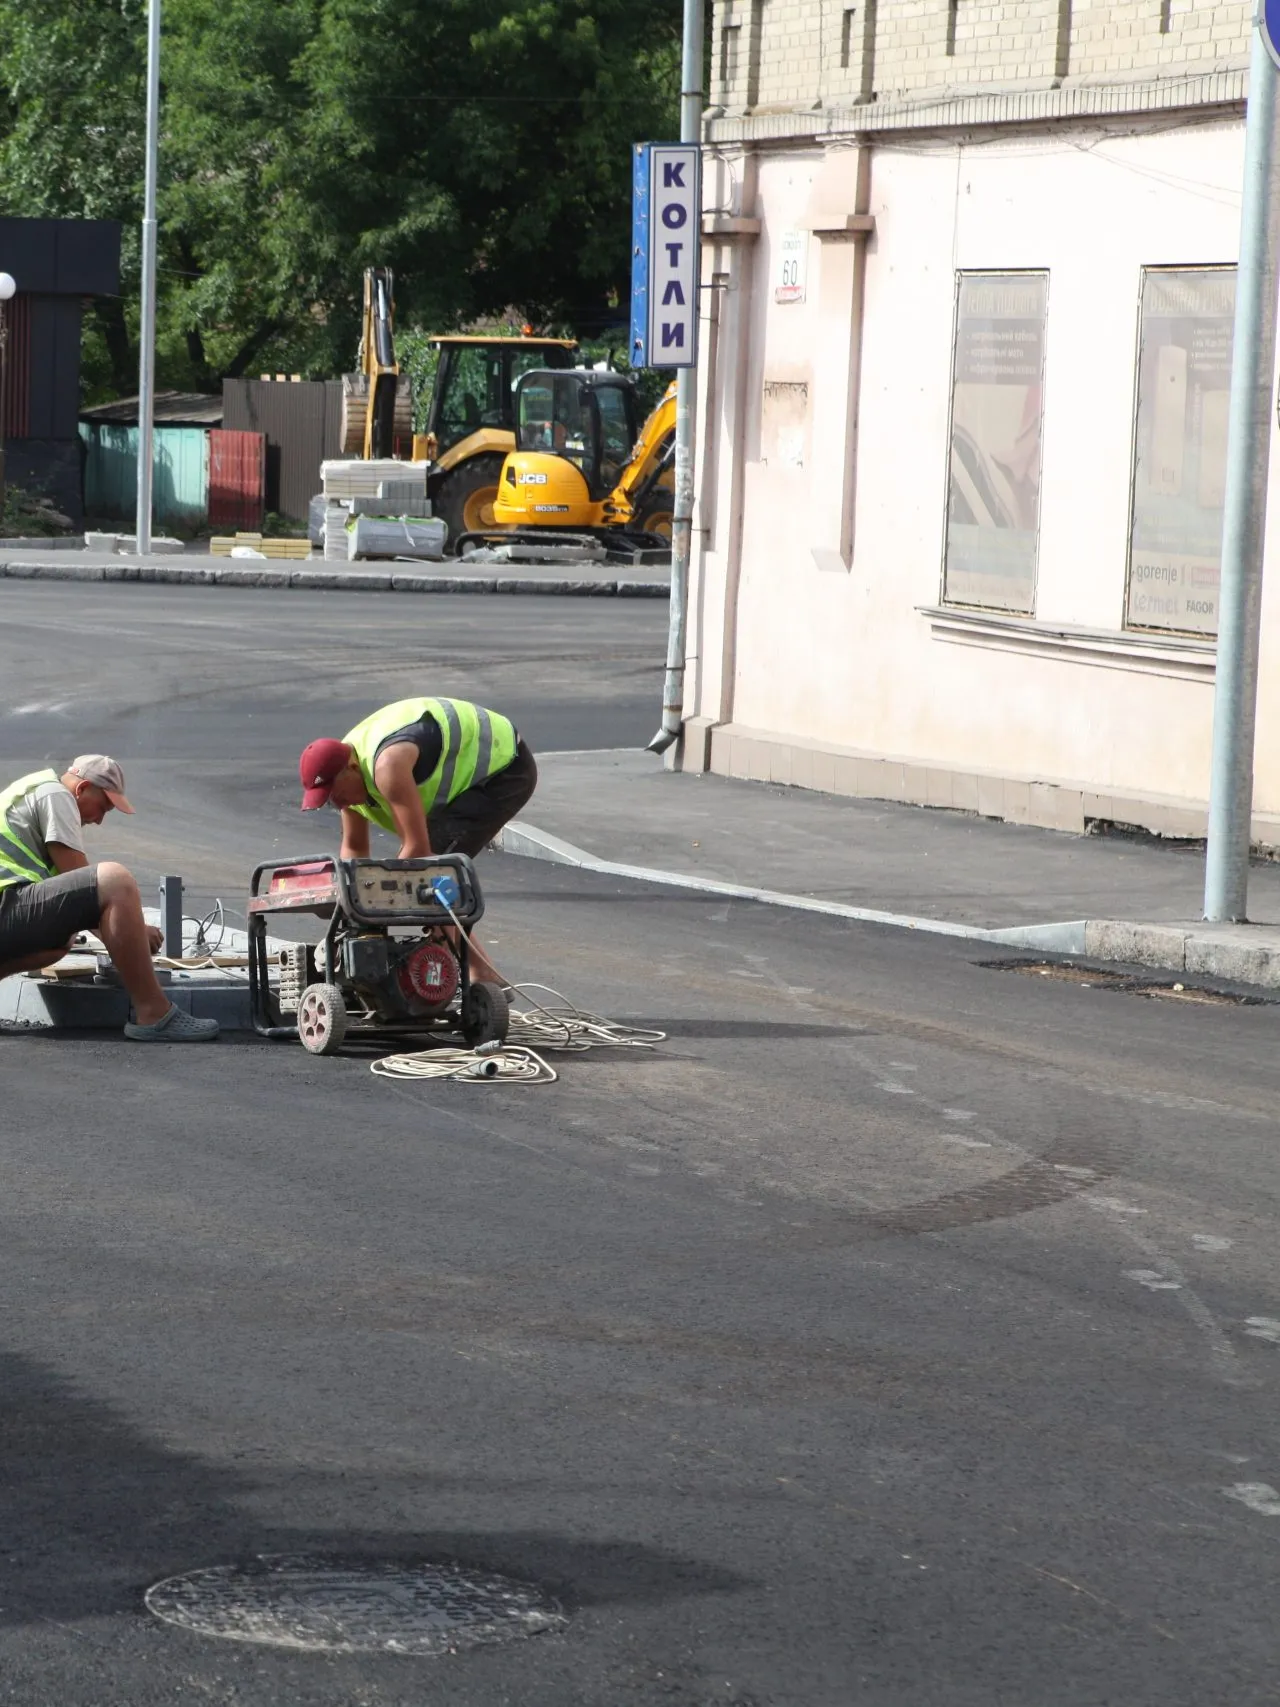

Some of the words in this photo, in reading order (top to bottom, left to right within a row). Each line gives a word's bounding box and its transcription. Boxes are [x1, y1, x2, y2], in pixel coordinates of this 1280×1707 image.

[661, 161, 688, 348] КОТЛИ
[782, 259, 798, 286] 60
[519, 472, 547, 484] JCB
[1136, 563, 1178, 586] gorenje
[1186, 599, 1215, 614] FAGOR
